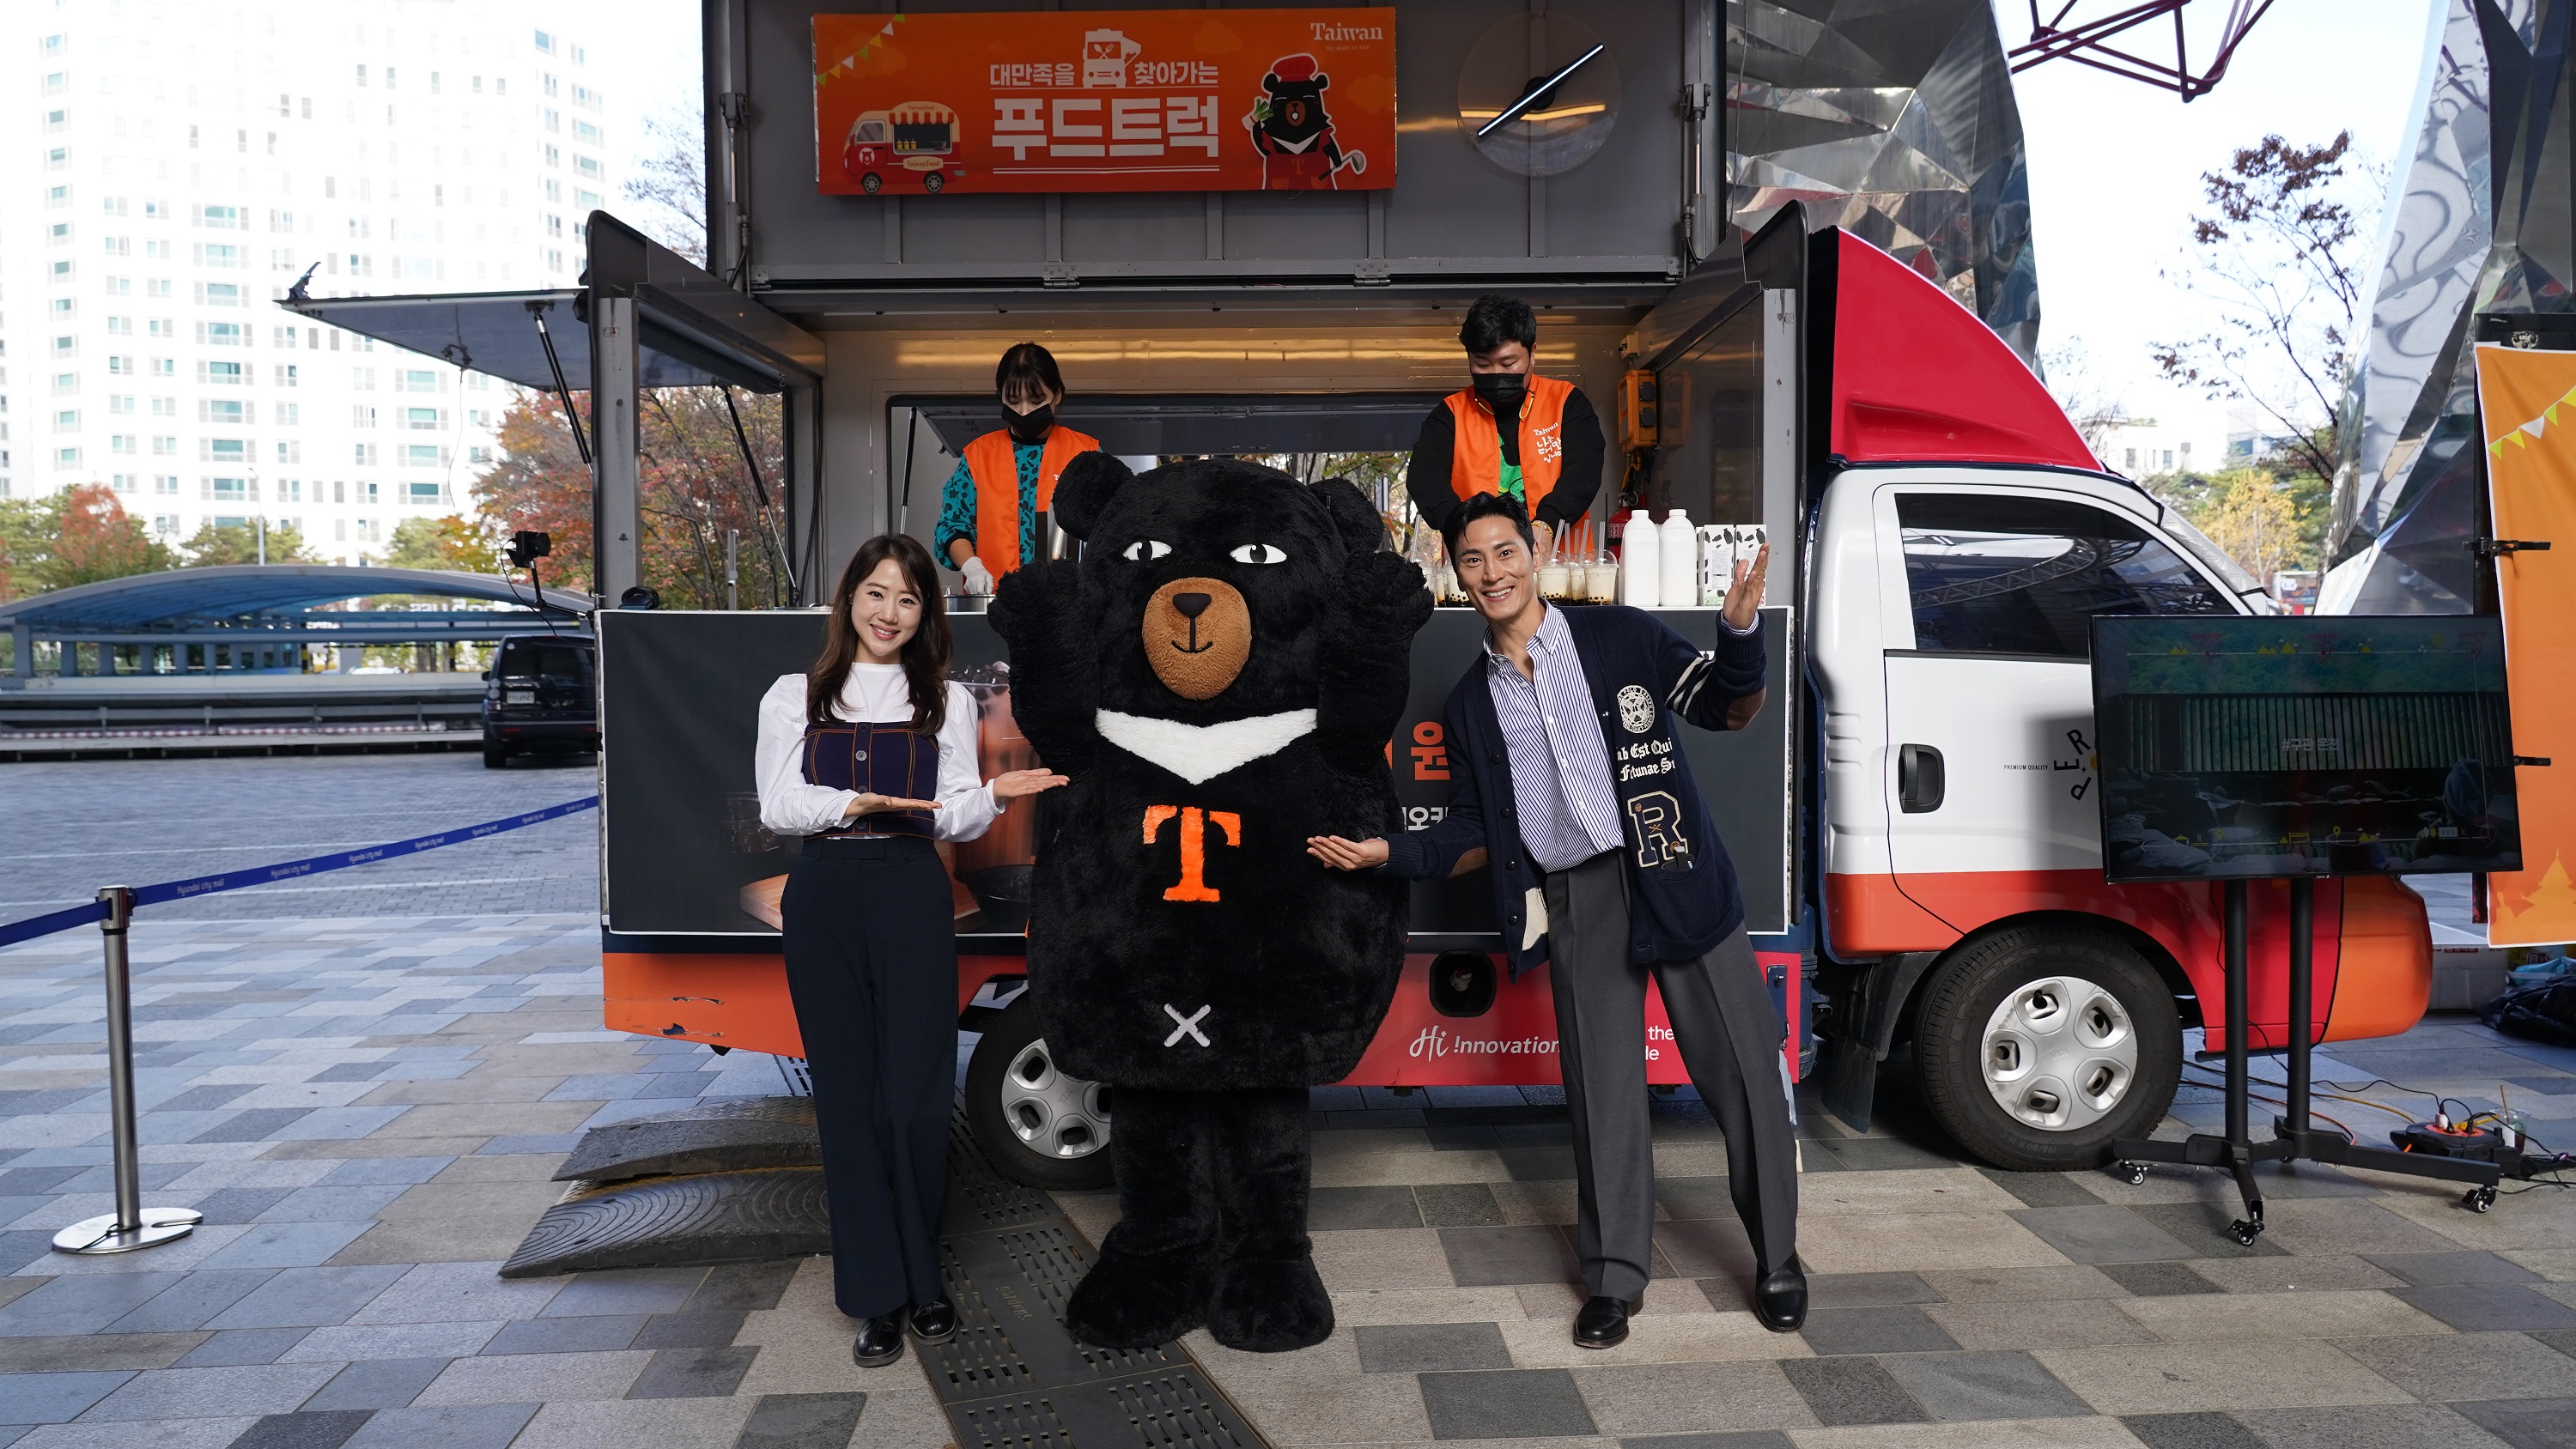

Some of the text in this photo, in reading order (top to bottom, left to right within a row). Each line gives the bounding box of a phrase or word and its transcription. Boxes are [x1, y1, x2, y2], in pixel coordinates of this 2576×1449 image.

[1310, 22, 1383, 41] Taiwan
[990, 61, 1218, 86] 대만족을 찾아가는
[992, 95, 1220, 161] 푸드트럭
[1533, 421, 1559, 436] Taiwan
[1630, 743, 1650, 759] Est
[1627, 791, 1688, 868] R
[1142, 804, 1242, 902] T
[201, 881, 212, 891] city
[213, 877, 225, 888] mall
[1648, 1025, 1674, 1040] the
[1409, 1025, 1449, 1063] Hi
[2026, 1143, 2057, 1154] 195/80
